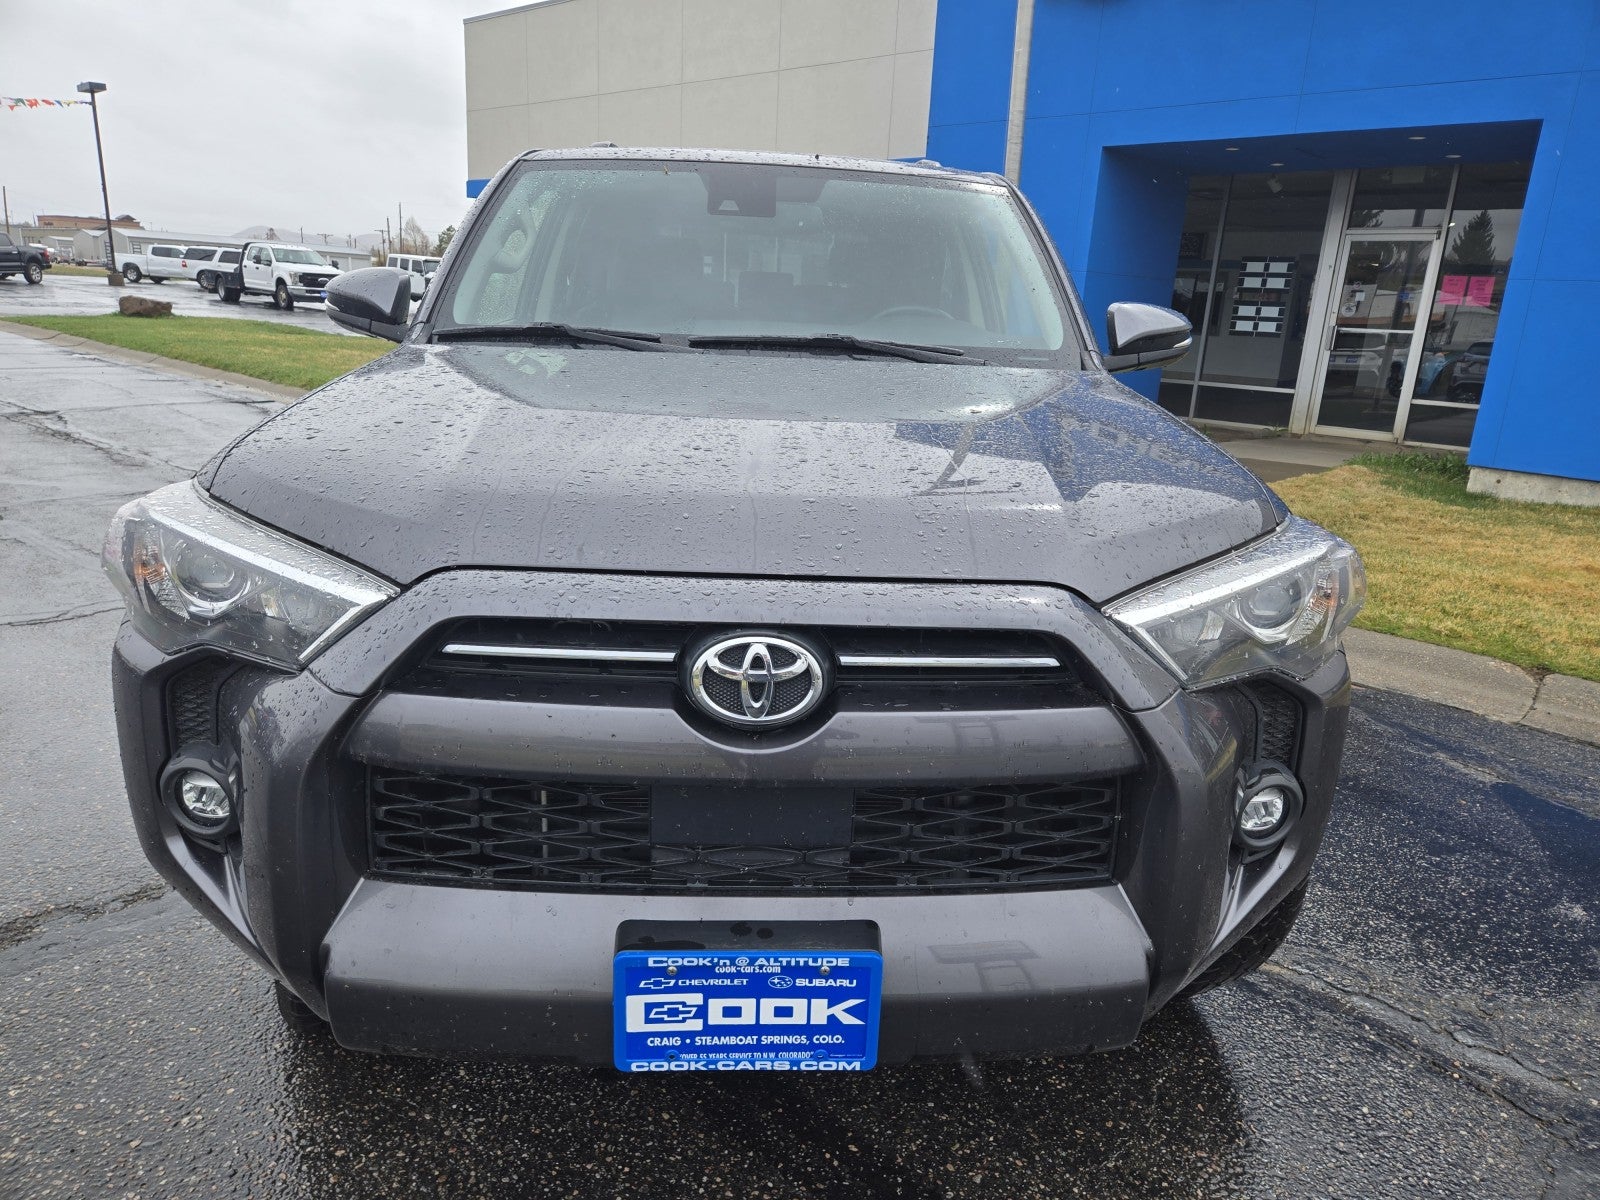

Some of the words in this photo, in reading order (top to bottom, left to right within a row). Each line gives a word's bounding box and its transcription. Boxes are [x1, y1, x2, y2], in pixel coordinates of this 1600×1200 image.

[735, 956, 750, 966] @
[754, 957, 850, 967] ALTITUDE
[714, 966, 781, 974] cook-cars.com
[678, 978, 749, 986] CHEVROLET
[795, 979, 857, 987] SUBARU
[626, 993, 866, 1033] COOK
[647, 1036, 681, 1047] CRAIG
[695, 1035, 758, 1046] STEAMBOAT
[761, 1034, 810, 1045] SPRINGS,
[813, 1034, 845, 1044] COLO.
[630, 1061, 861, 1071] COOK-CARS.COM
